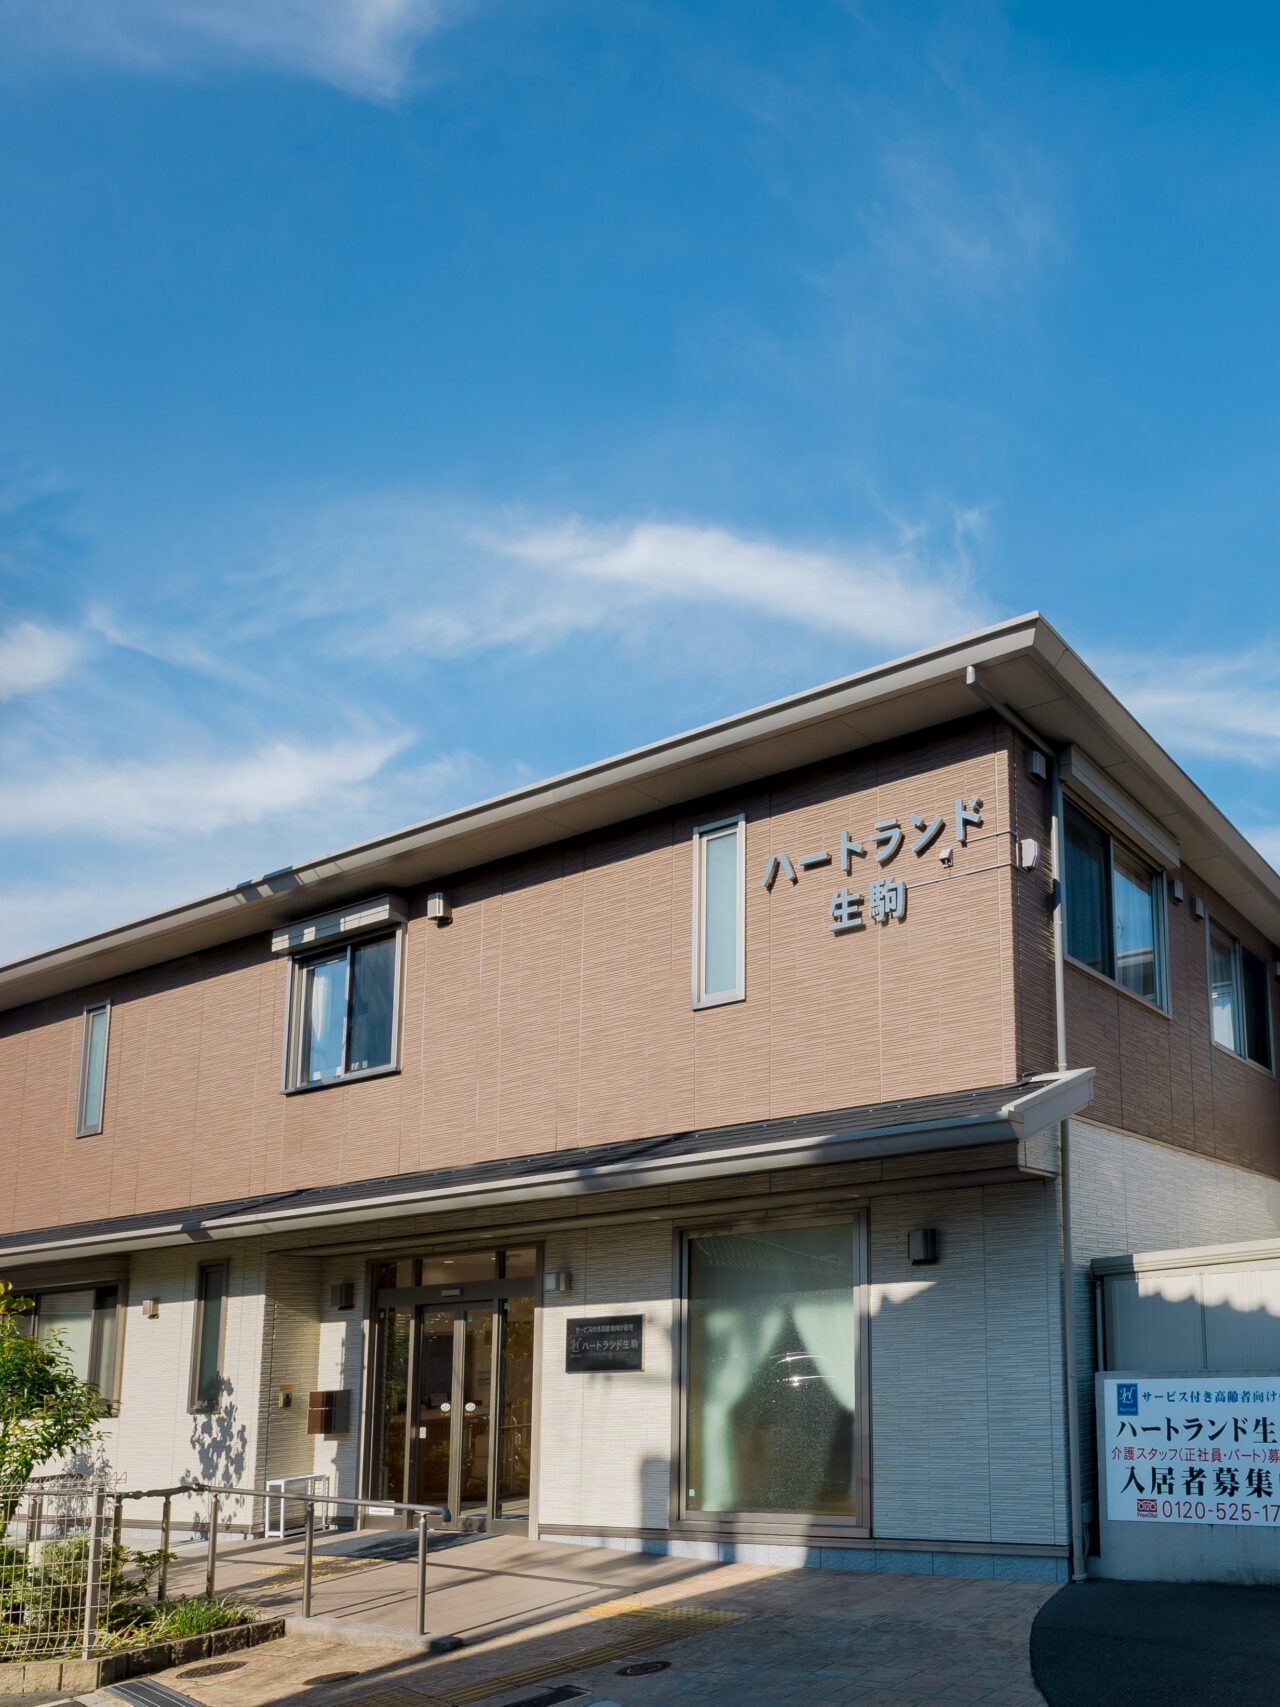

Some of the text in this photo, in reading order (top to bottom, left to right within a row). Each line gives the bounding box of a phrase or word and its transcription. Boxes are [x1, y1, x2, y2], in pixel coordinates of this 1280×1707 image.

[761, 794, 983, 889] ハートランド
[828, 877, 906, 932] 生駒
[581, 1338, 639, 1351] ハートランド生駒
